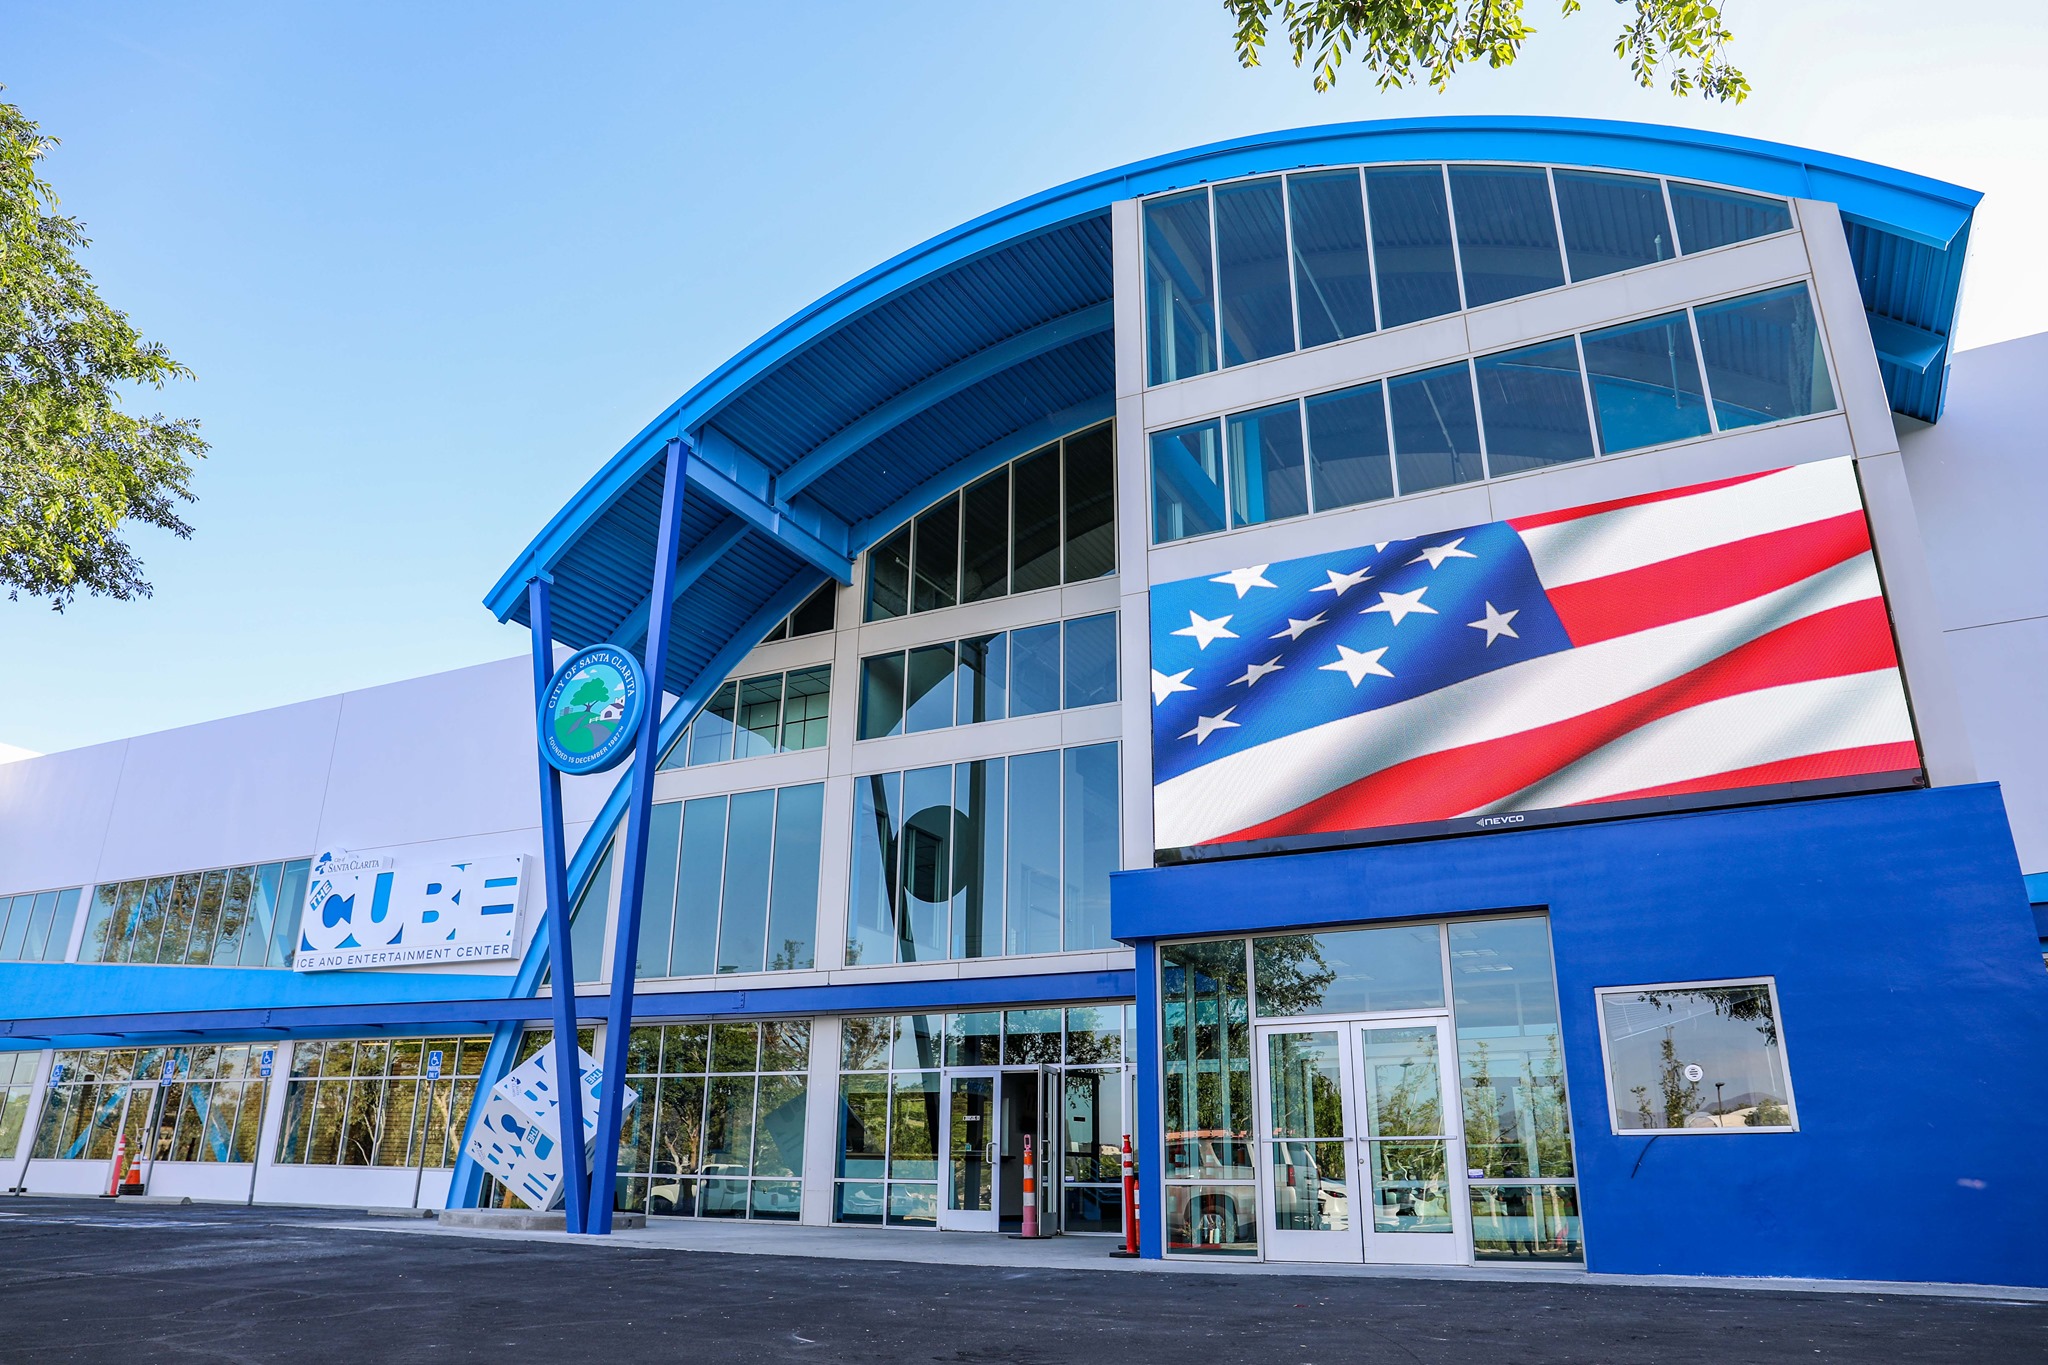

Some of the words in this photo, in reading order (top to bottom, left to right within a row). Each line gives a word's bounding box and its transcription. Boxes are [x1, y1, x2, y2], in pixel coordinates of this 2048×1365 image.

[548, 680, 565, 709] CITY
[565, 665, 578, 680] OF
[579, 653, 609, 668] SANTA
[611, 656, 635, 697] CLARITA
[549, 736, 568, 760] FOUNDED
[575, 746, 608, 764] DECEMBER
[1485, 815, 1524, 826] NEVCO
[302, 856, 517, 951] CUBE
[310, 880, 332, 910] THE
[296, 958, 315, 969] ICE
[318, 956, 343, 967] AND
[347, 948, 452, 965] ENTERTAINMENT
[456, 944, 510, 957] CENTER
[526, 1127, 539, 1144] THE
